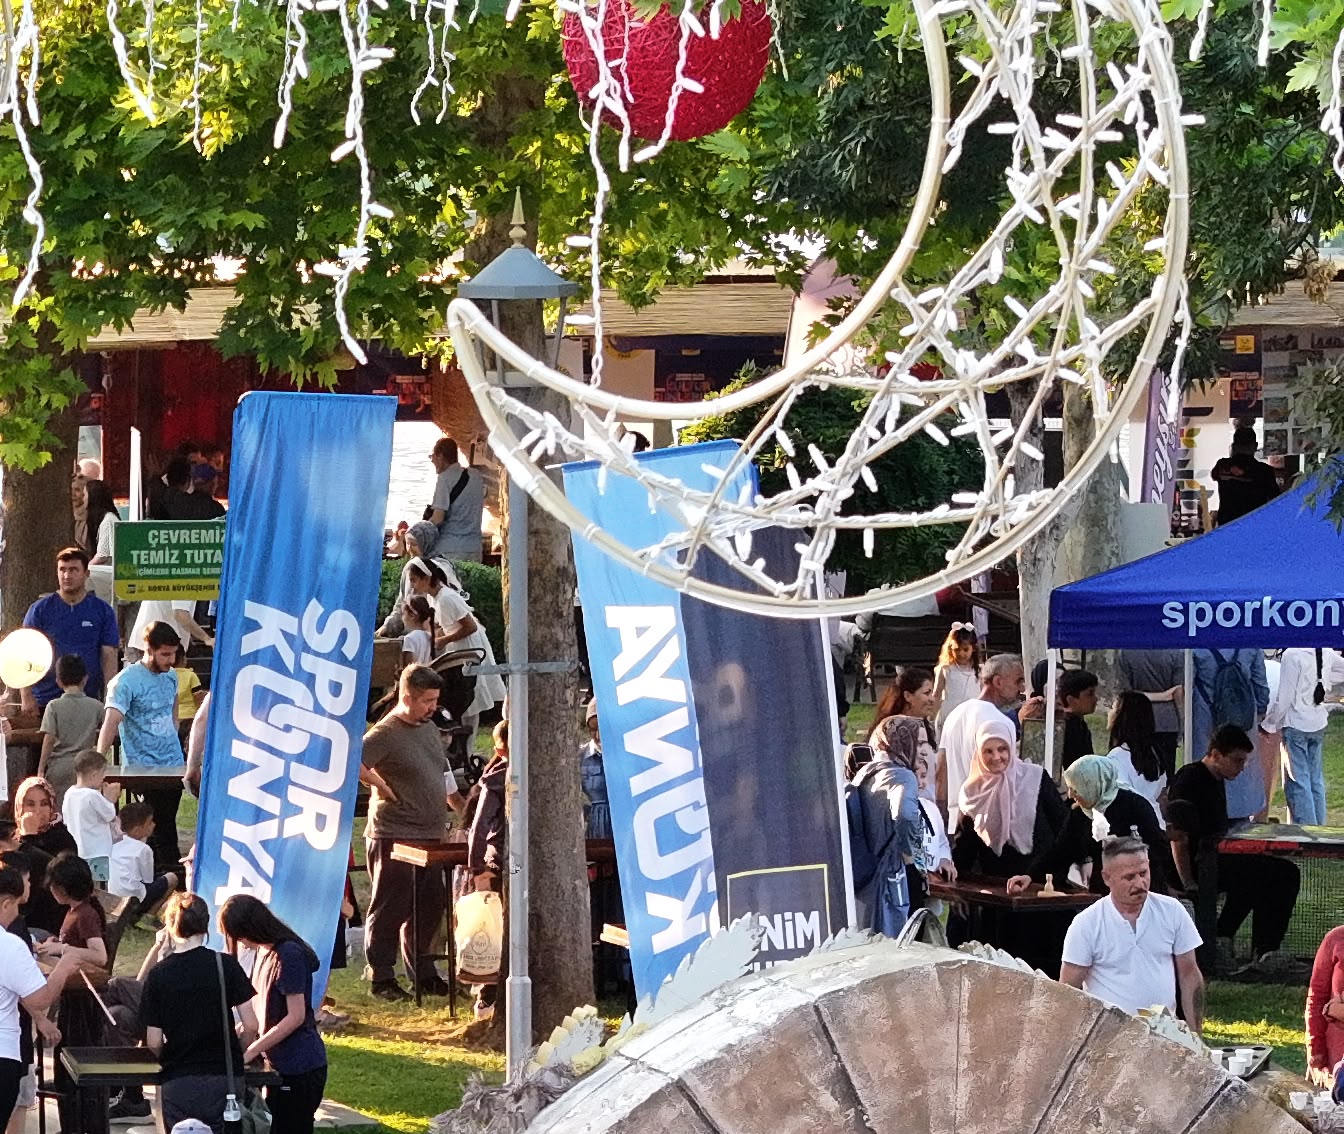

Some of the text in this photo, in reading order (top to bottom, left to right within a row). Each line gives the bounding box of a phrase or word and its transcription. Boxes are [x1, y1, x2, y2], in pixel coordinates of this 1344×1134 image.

[130, 547, 179, 564] TEMİZ
[1161, 595, 1344, 637] sporkon
[214, 599, 314, 907] KONYA
[280, 597, 361, 852] SPOR
